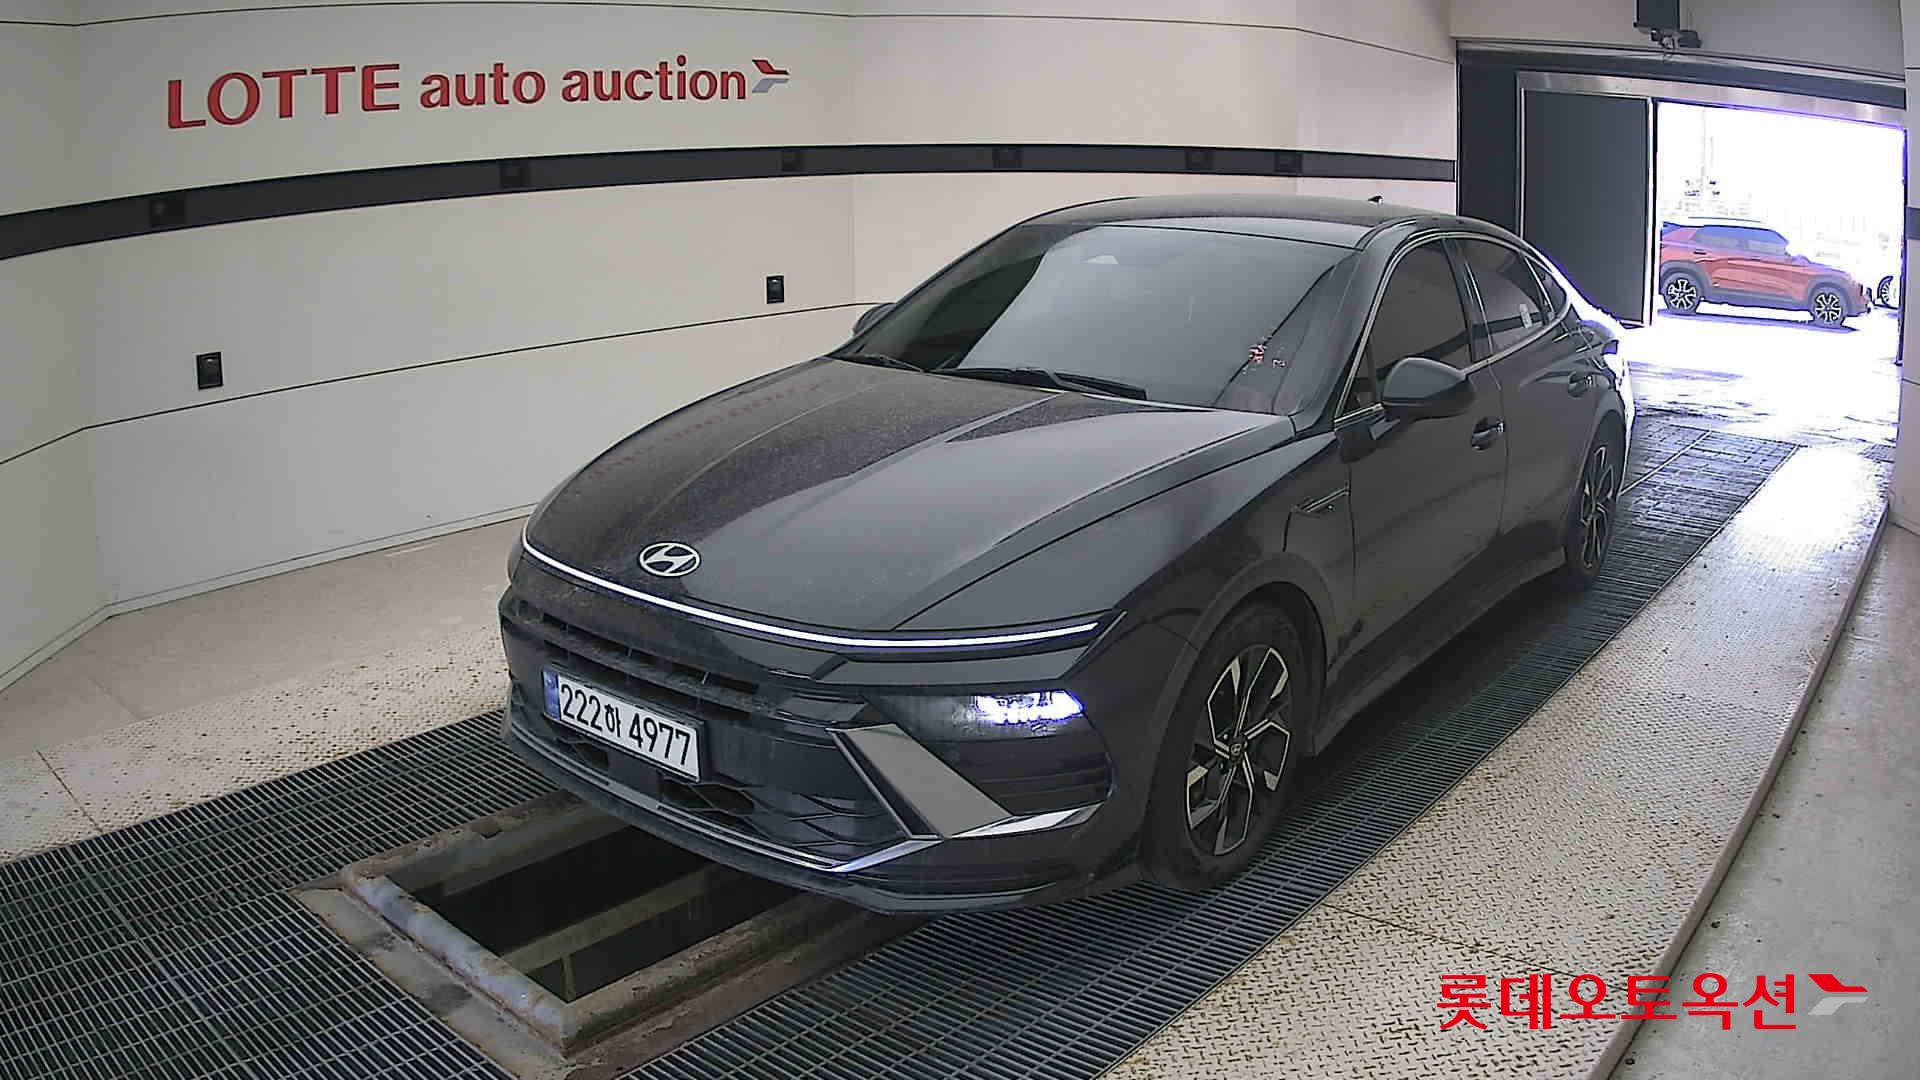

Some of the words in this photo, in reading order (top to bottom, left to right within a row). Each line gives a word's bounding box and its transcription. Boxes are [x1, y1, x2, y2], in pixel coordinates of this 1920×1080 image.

[168, 62, 400, 129] LOTTE
[420, 62, 546, 109] auto
[561, 54, 747, 103] auction
[629, 713, 691, 766] 4977
